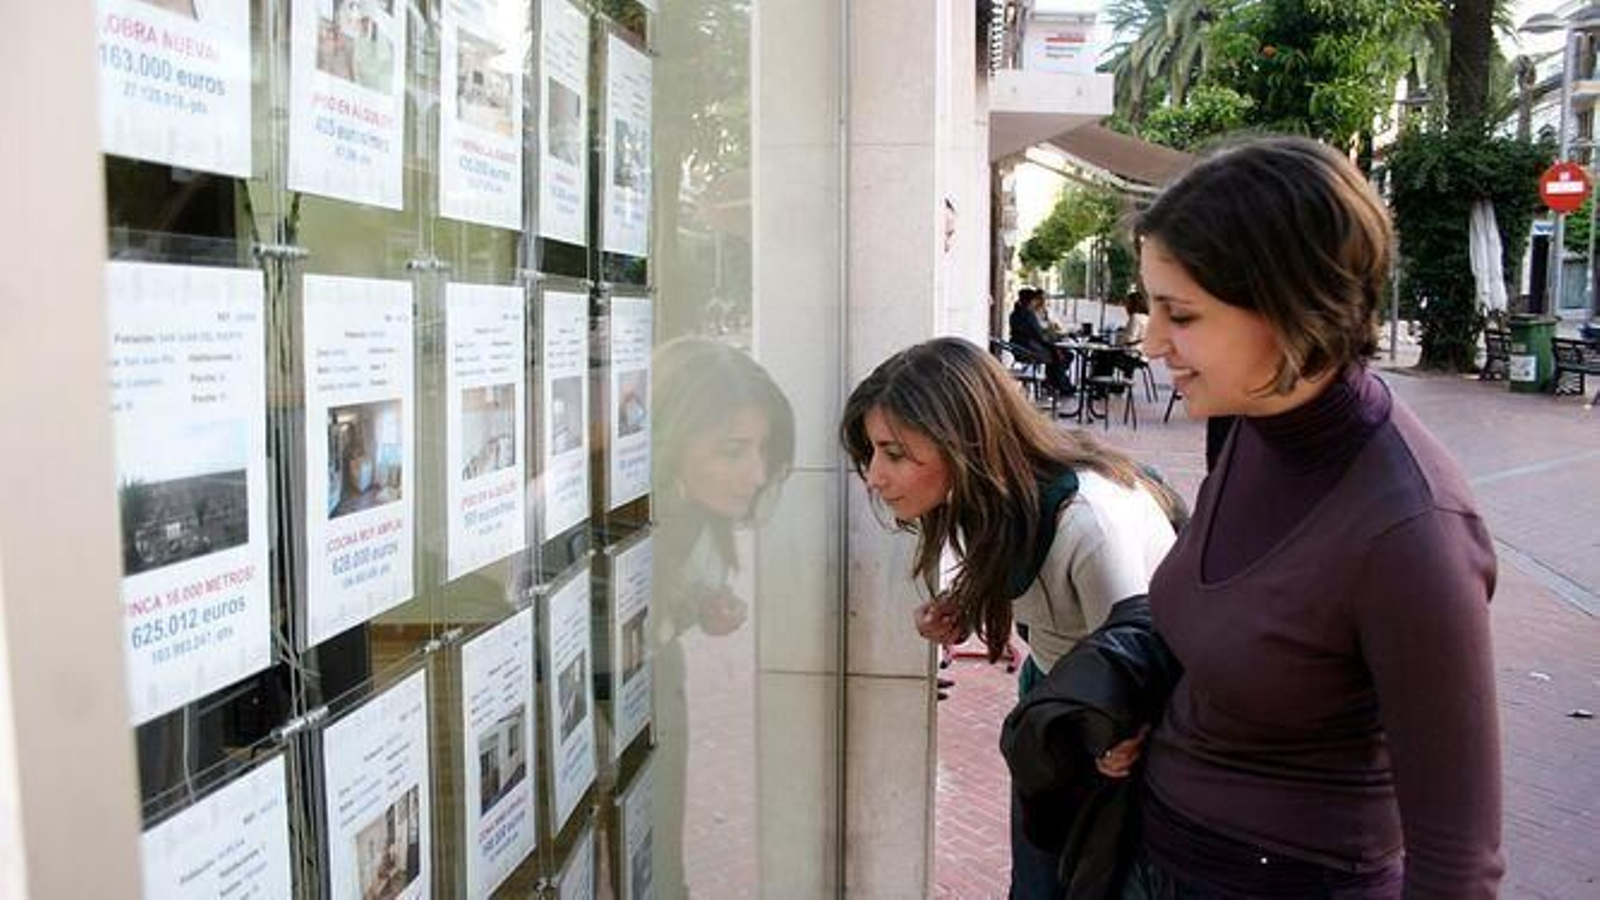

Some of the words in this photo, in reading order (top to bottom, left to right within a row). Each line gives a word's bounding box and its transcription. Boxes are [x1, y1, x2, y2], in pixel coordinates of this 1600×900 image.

[99, 44, 172, 82] 163.000
[176, 69, 225, 96] euros
[132, 608, 198, 649] 625.012
[203, 596, 246, 623] euros
